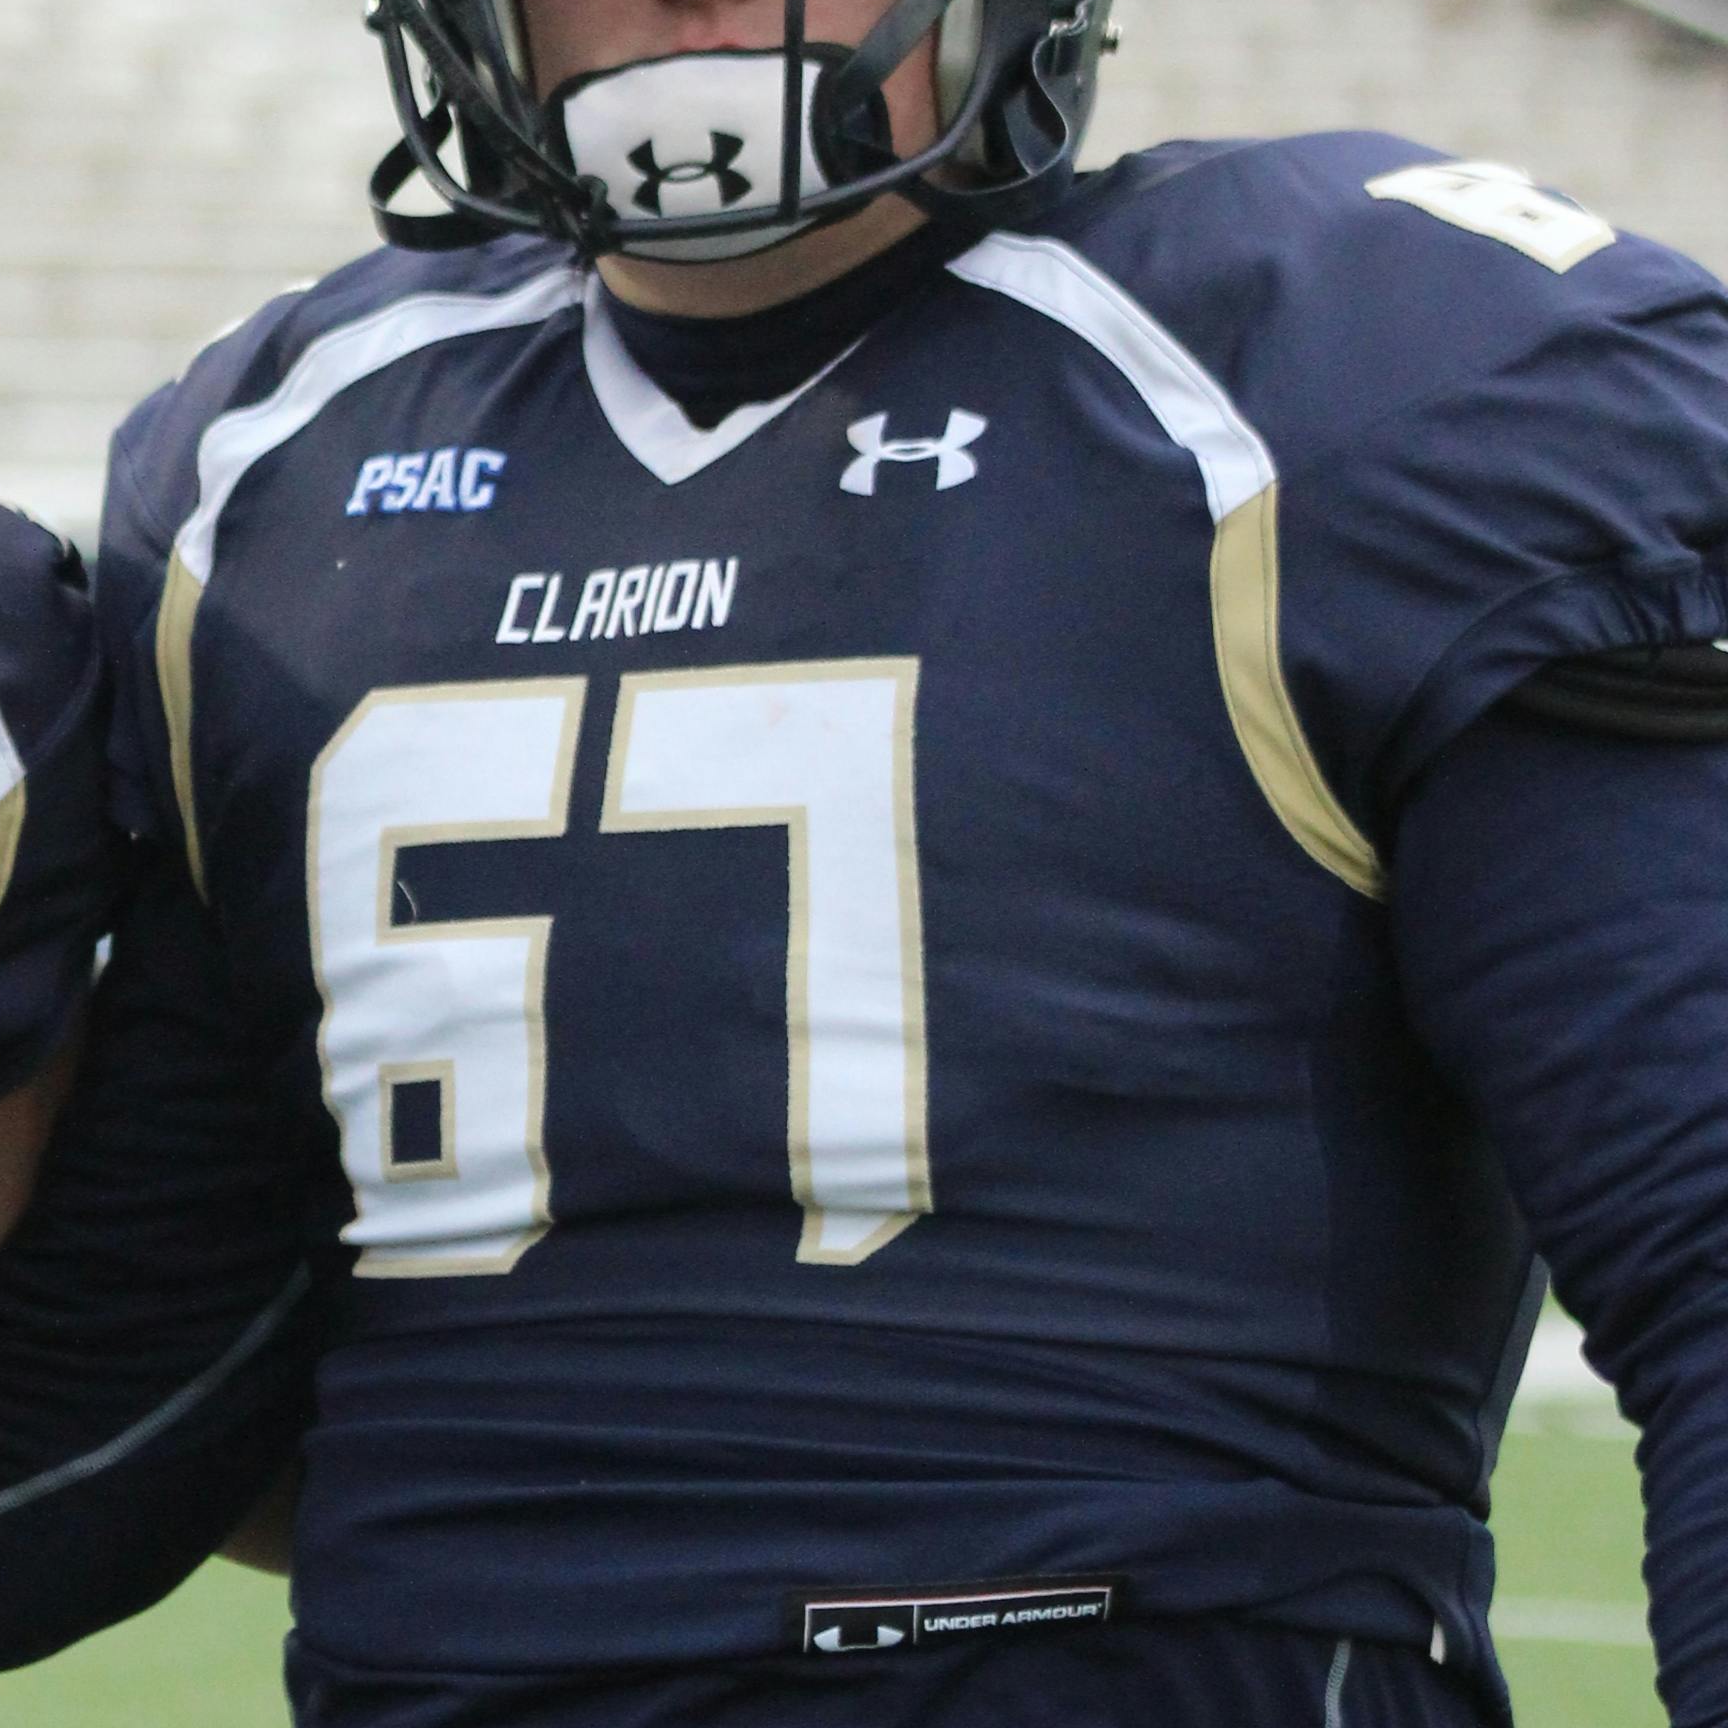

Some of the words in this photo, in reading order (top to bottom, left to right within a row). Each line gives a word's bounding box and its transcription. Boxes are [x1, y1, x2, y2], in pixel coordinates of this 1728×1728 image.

[346, 445, 506, 515] PSAC
[495, 557, 740, 644] CLARION
[305, 656, 934, 1279] 67
[923, 1614, 997, 1633] UNDER
[1000, 1604, 1098, 1625] ARMOUR
